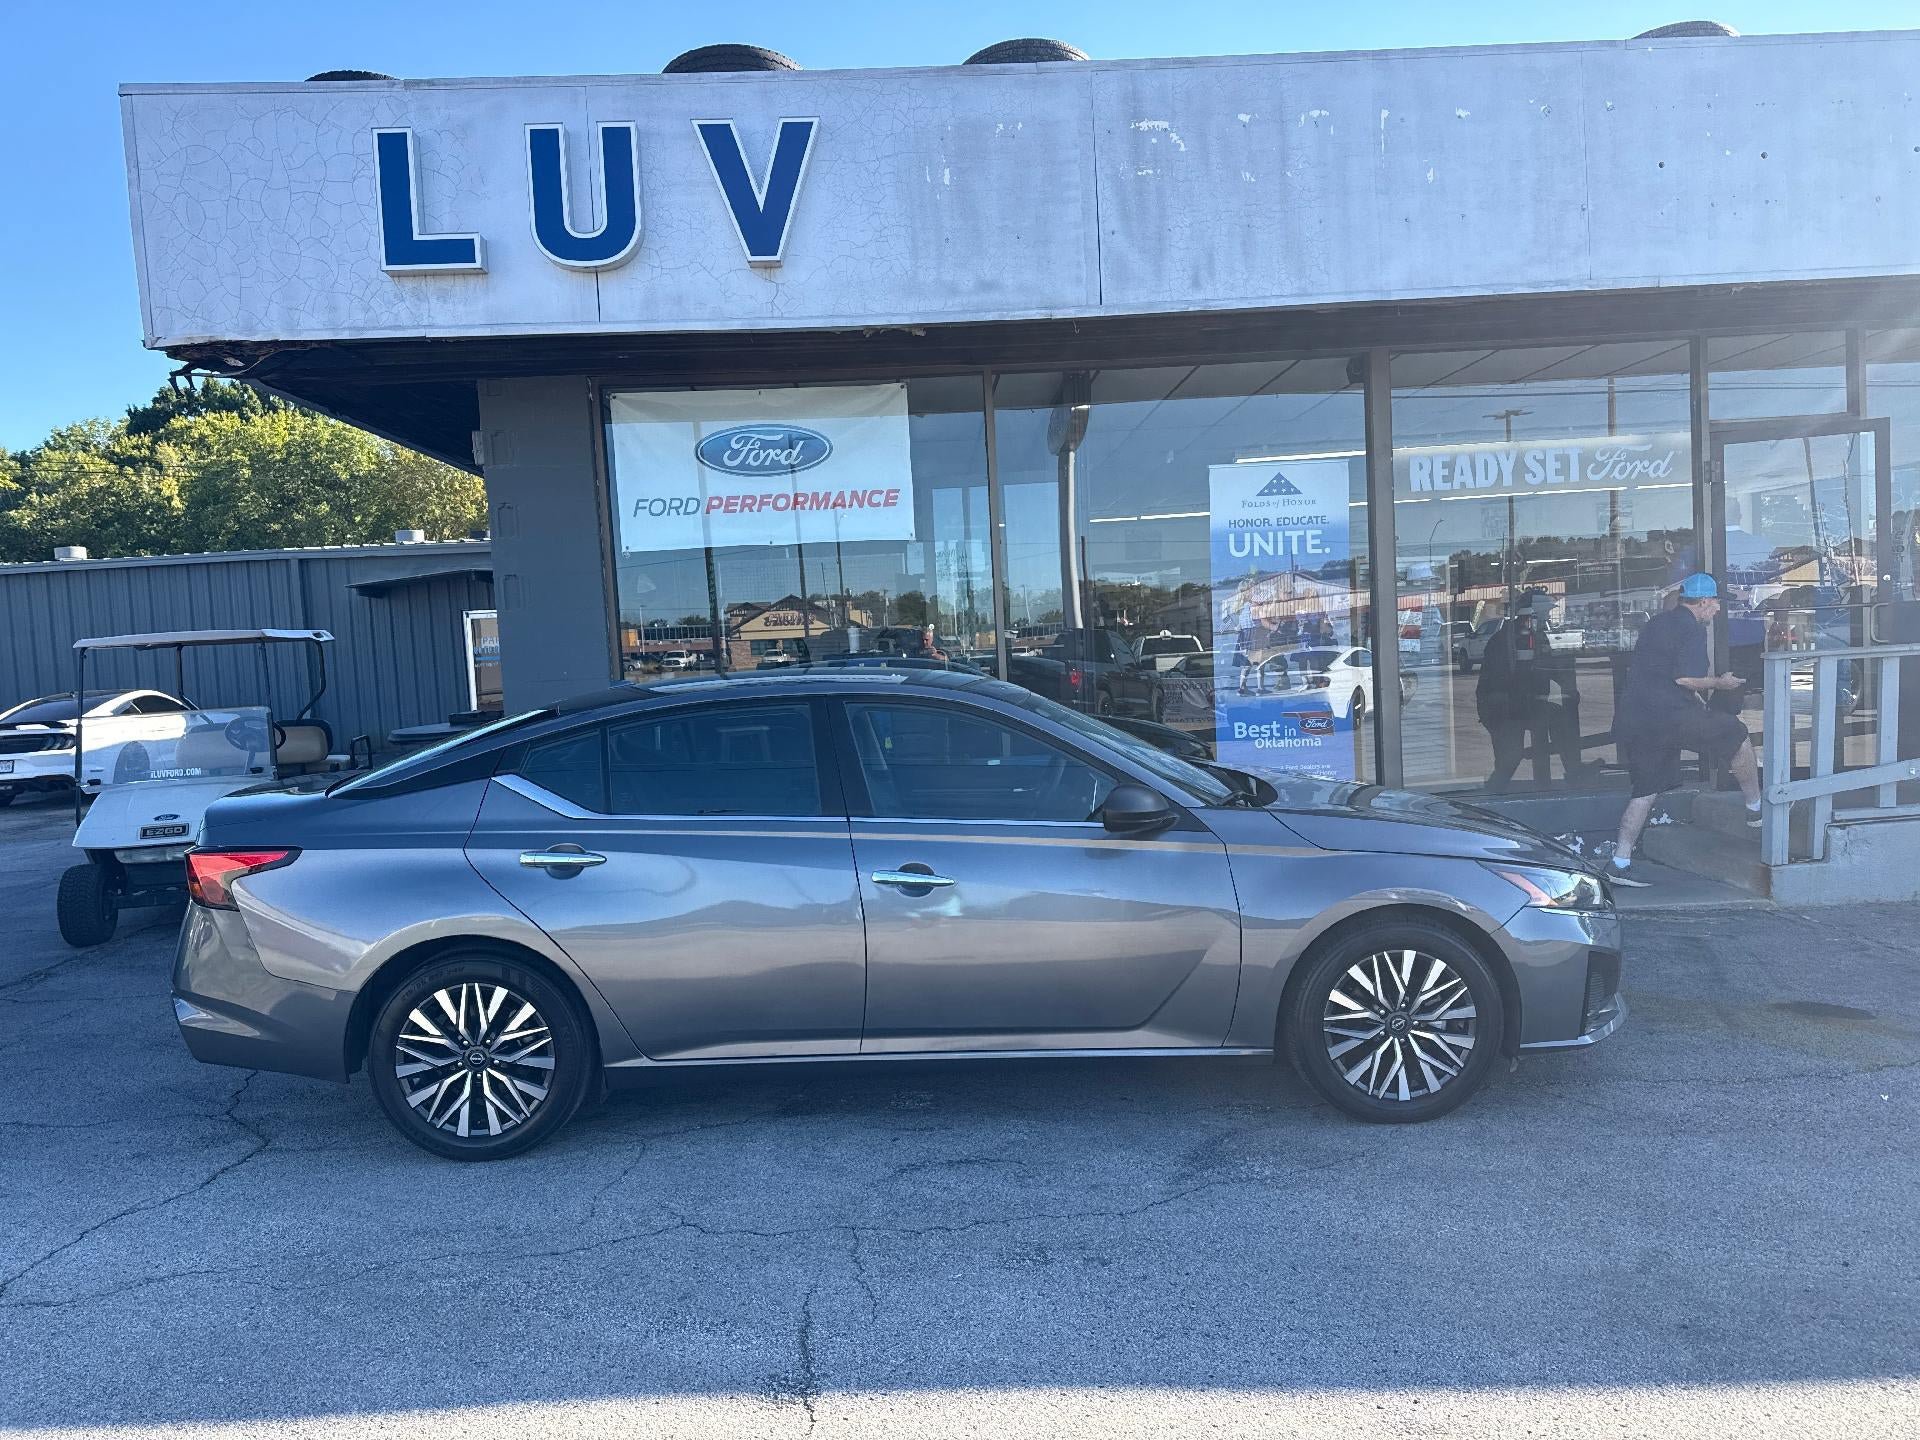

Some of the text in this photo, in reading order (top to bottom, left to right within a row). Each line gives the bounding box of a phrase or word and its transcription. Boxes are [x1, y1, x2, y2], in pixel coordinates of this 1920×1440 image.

[371, 115, 820, 275] LUV
[722, 432, 804, 467] Ford
[1409, 443, 1673, 493] READY SET Ford
[633, 488, 901, 518] FORD PERFORMANCE
[1228, 515, 1330, 528] HONOR. EDUCATE.
[1228, 529, 1331, 557] UNITE.
[1234, 721, 1297, 738] Best in
[1305, 720, 1327, 728] Ford
[1254, 737, 1321, 748] Oklahoma
